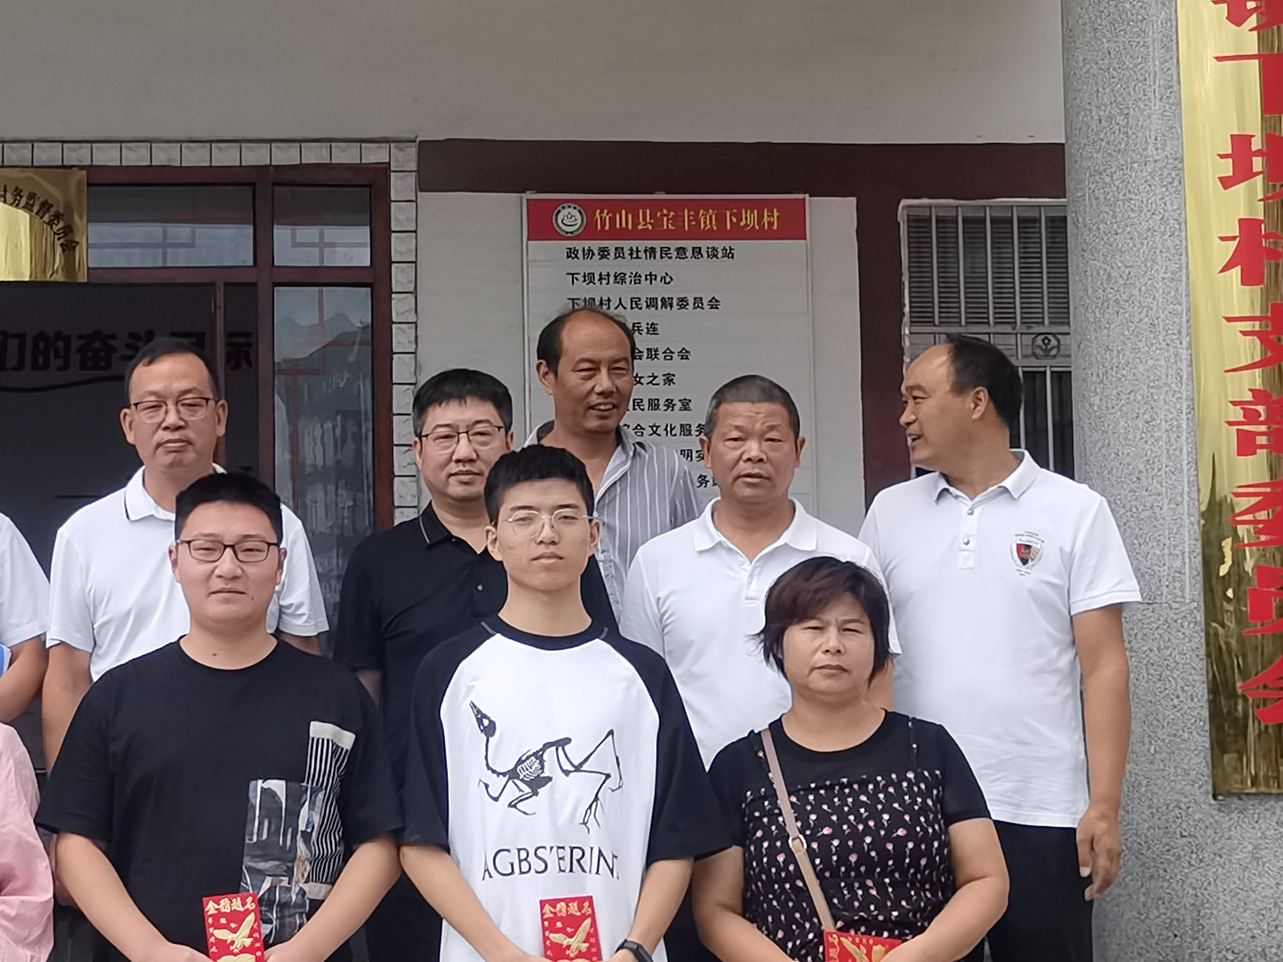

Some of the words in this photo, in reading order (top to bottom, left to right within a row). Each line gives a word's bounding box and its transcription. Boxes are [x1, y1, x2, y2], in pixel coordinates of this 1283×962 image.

[594, 208, 780, 231] 竹山县宝丰镇下坝村
[566, 246, 735, 260] 政协委员社情民意恳谈站
[566, 271, 674, 285] 下坝村综治中心
[567, 297, 721, 310] 下坝村人民调解委员会
[627, 398, 693, 412] 民服务室
